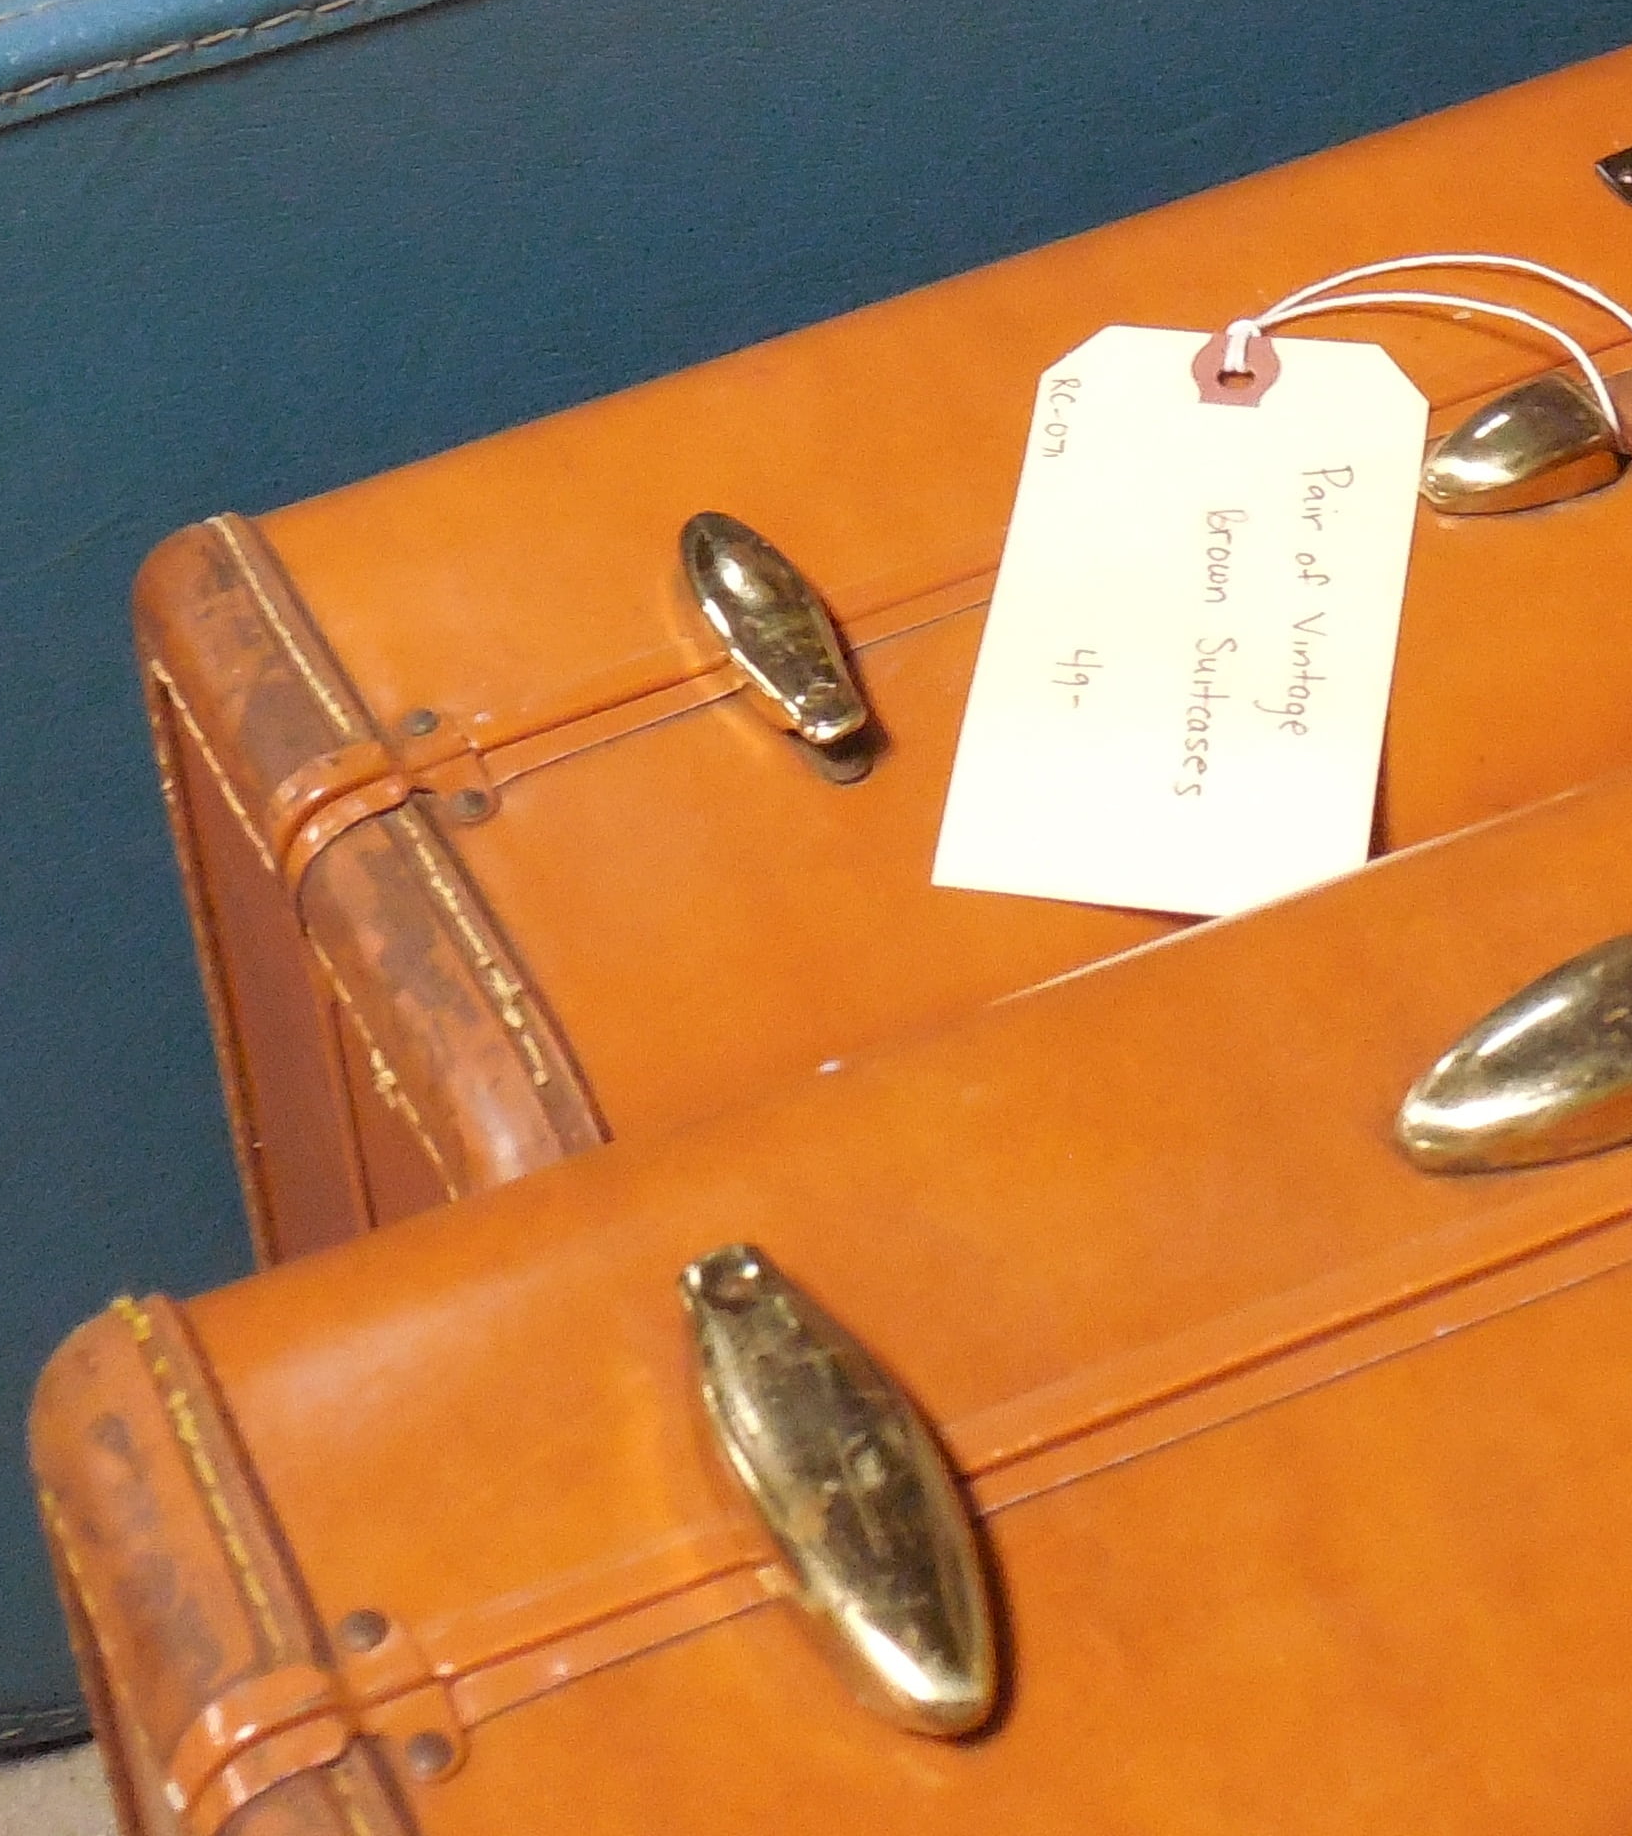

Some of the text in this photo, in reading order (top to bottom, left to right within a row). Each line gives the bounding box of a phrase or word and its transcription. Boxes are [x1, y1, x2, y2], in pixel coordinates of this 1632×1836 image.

[1171, 509, 1246, 798] Brown Suitcases
[1252, 465, 1353, 736] Pair of Vintage
